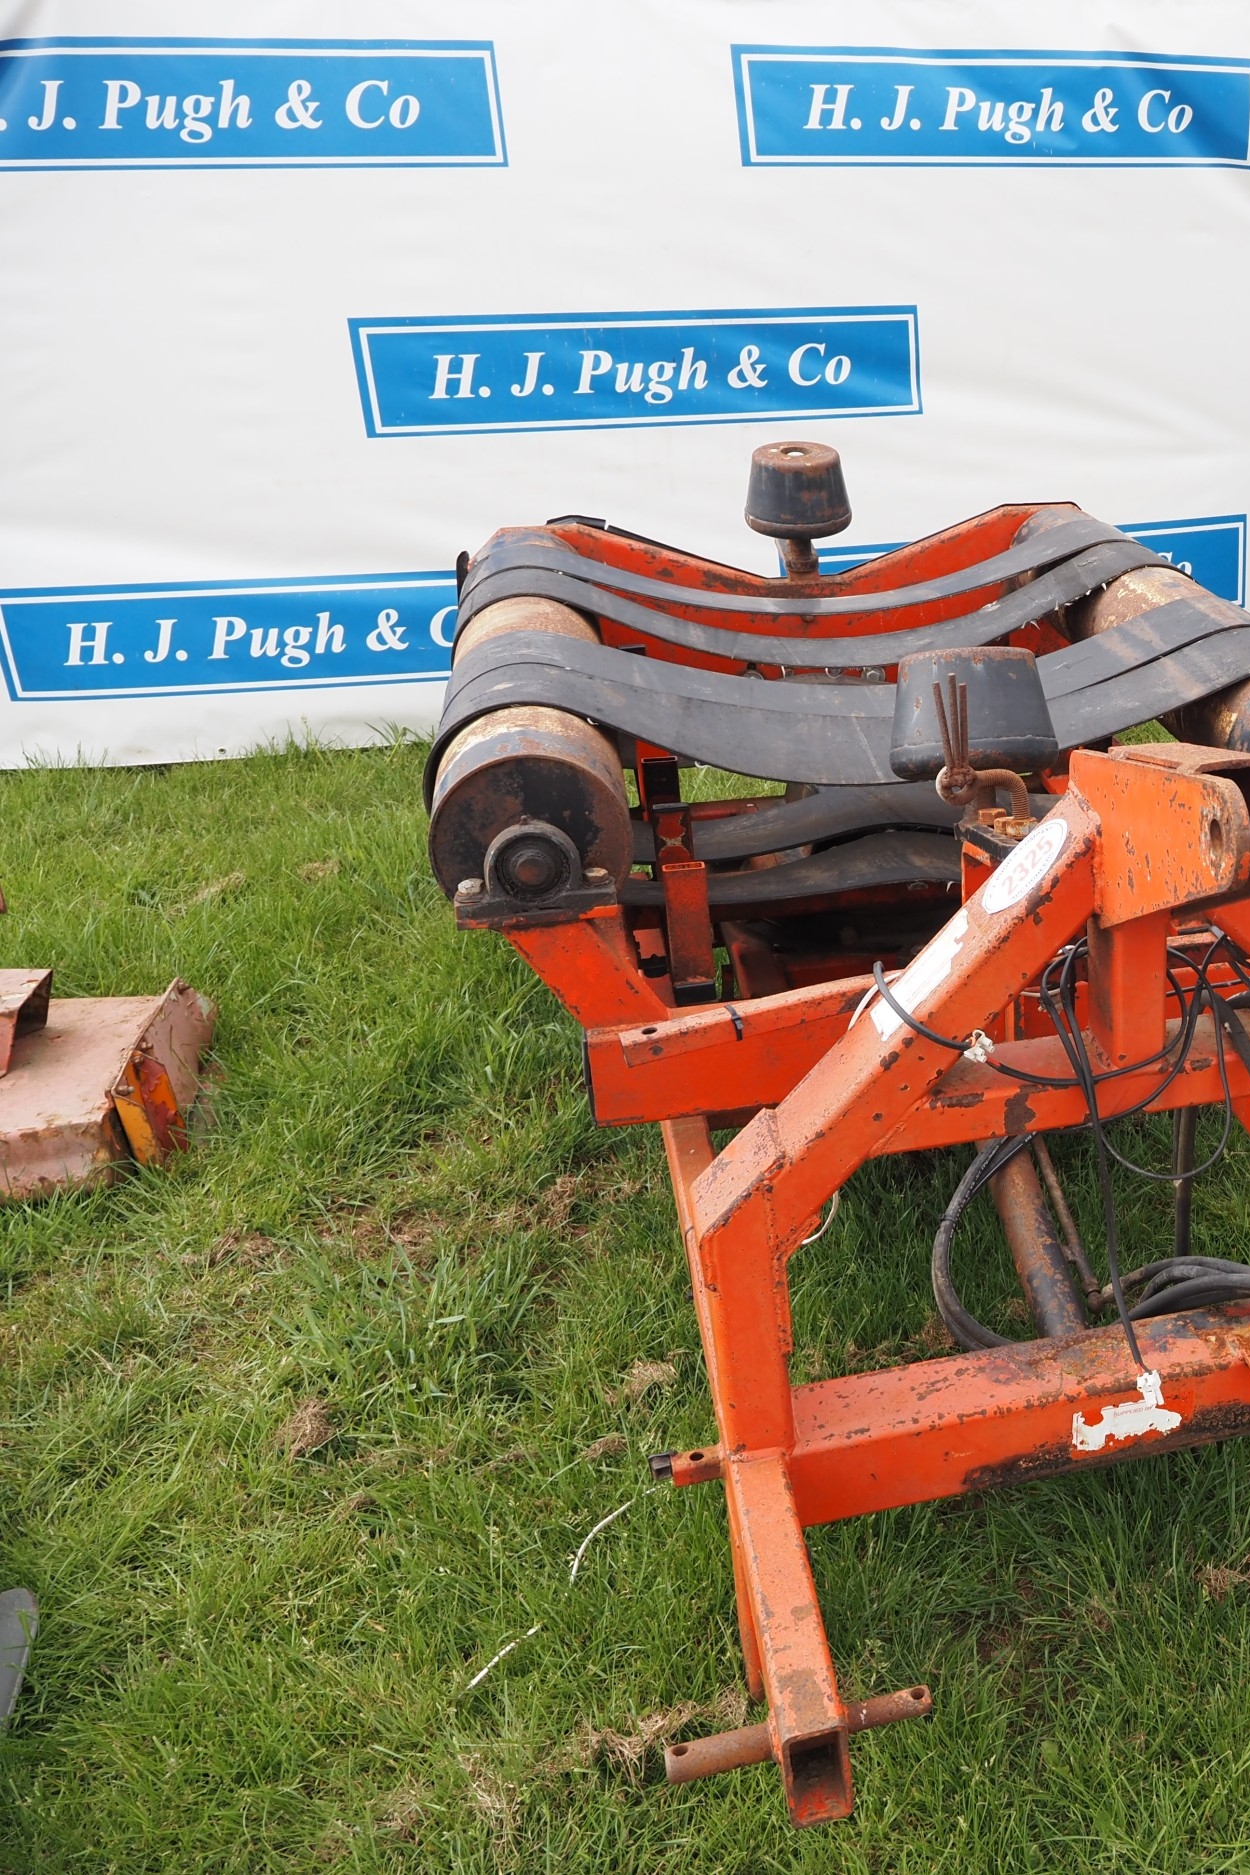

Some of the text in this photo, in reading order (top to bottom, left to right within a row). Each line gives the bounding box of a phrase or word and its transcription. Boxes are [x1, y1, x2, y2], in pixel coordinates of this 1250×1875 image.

[28, 80, 420, 143] J. Pugh & Co
[803, 85, 1192, 143] H. J. Pugh & Co
[429, 344, 850, 403] H. J. Pugh & Co
[64, 605, 458, 667] H. J. Pugh & C
[1002, 836, 1054, 896] 2325
